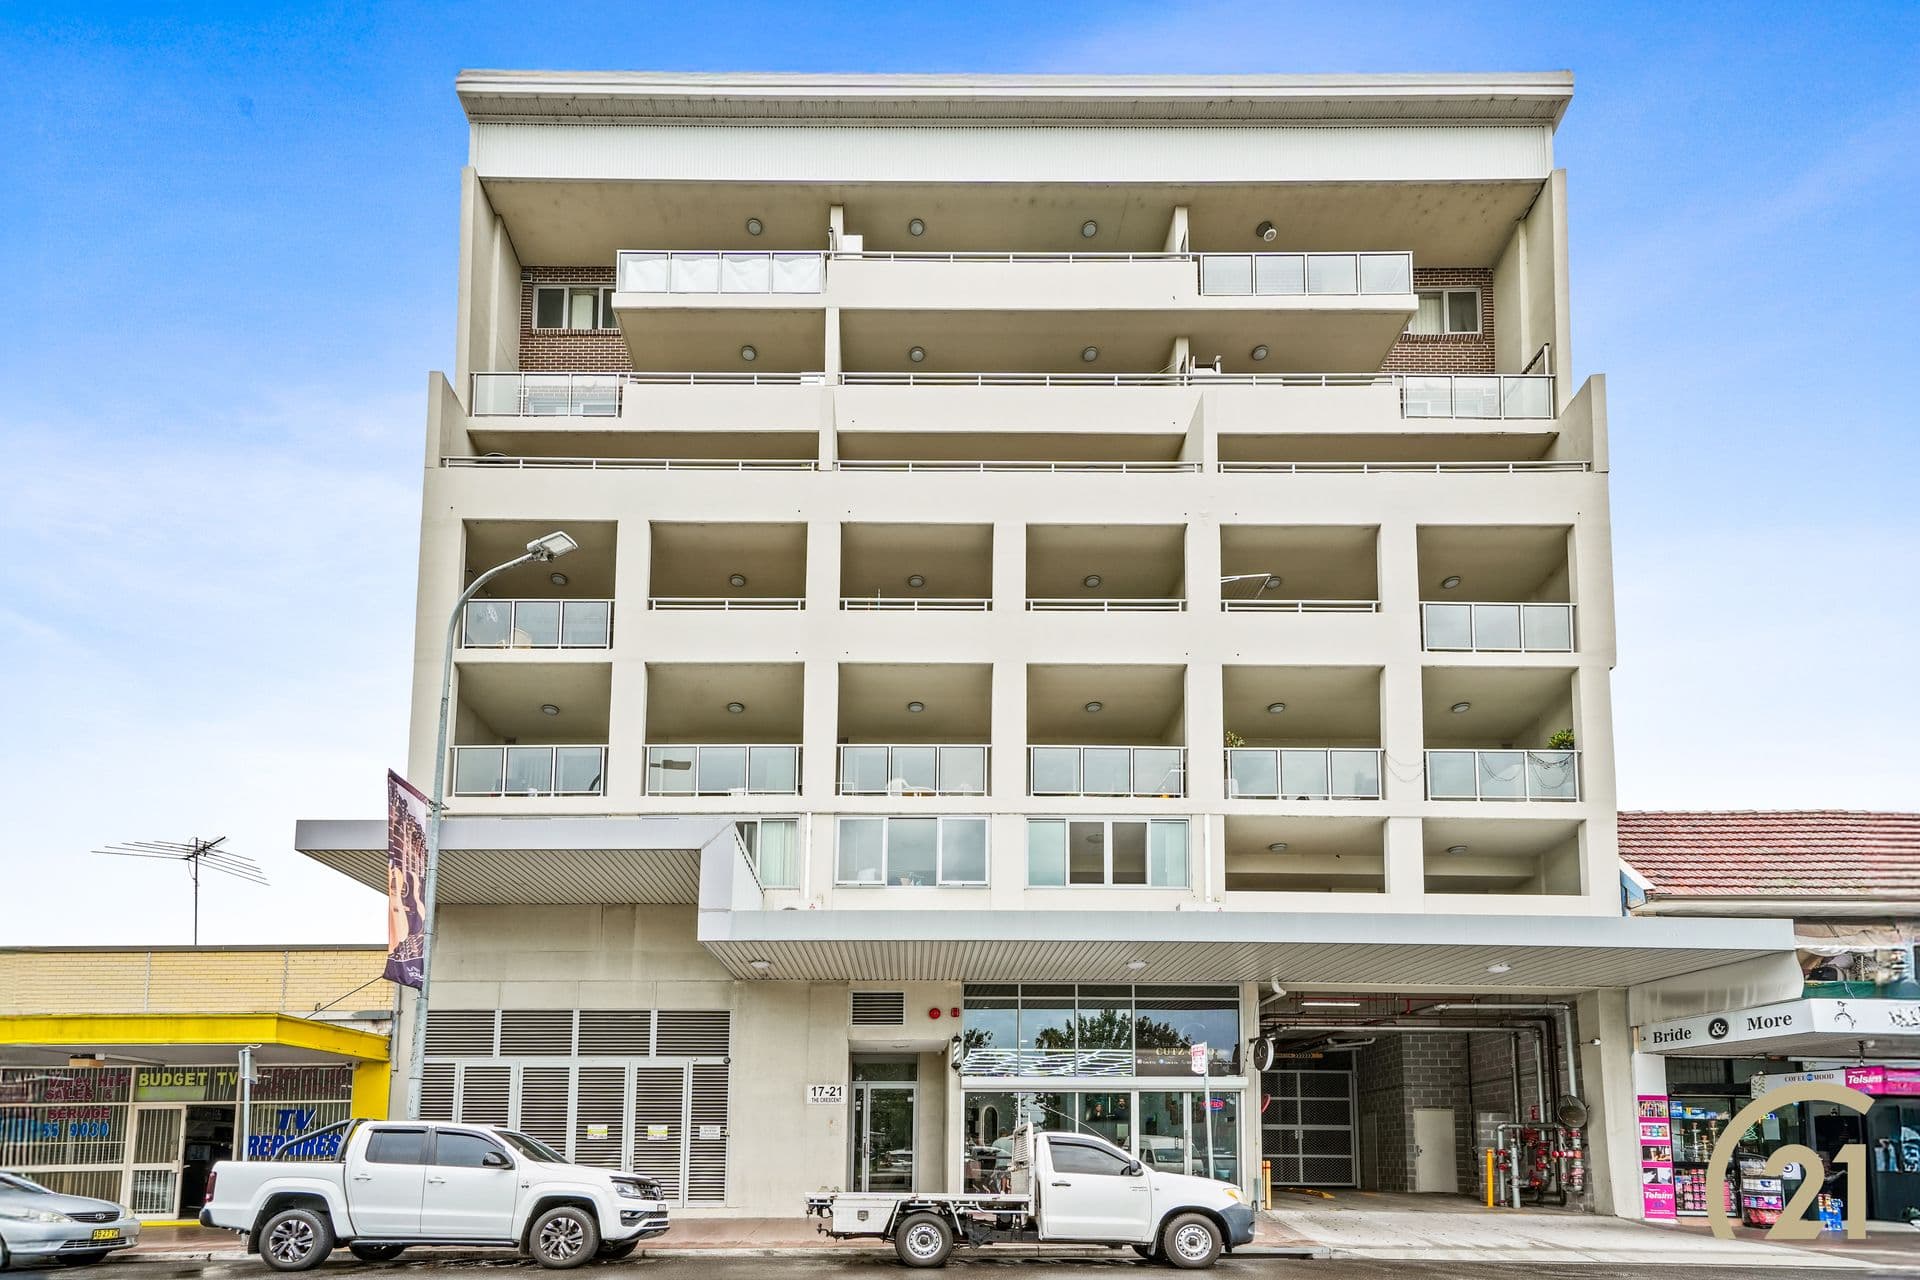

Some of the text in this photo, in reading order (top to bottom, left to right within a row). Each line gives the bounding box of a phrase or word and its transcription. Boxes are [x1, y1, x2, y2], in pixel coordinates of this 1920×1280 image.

[1653, 1014, 1792, 1043] Bride & More
[138, 1071, 238, 1087] BUDGET TV
[1847, 1071, 1883, 1085] Telsim
[45, 1088, 94, 1101] SALES
[811, 1086, 842, 1097] 17-21
[47, 1108, 111, 1120] SERVICE
[276, 1109, 317, 1131] TV
